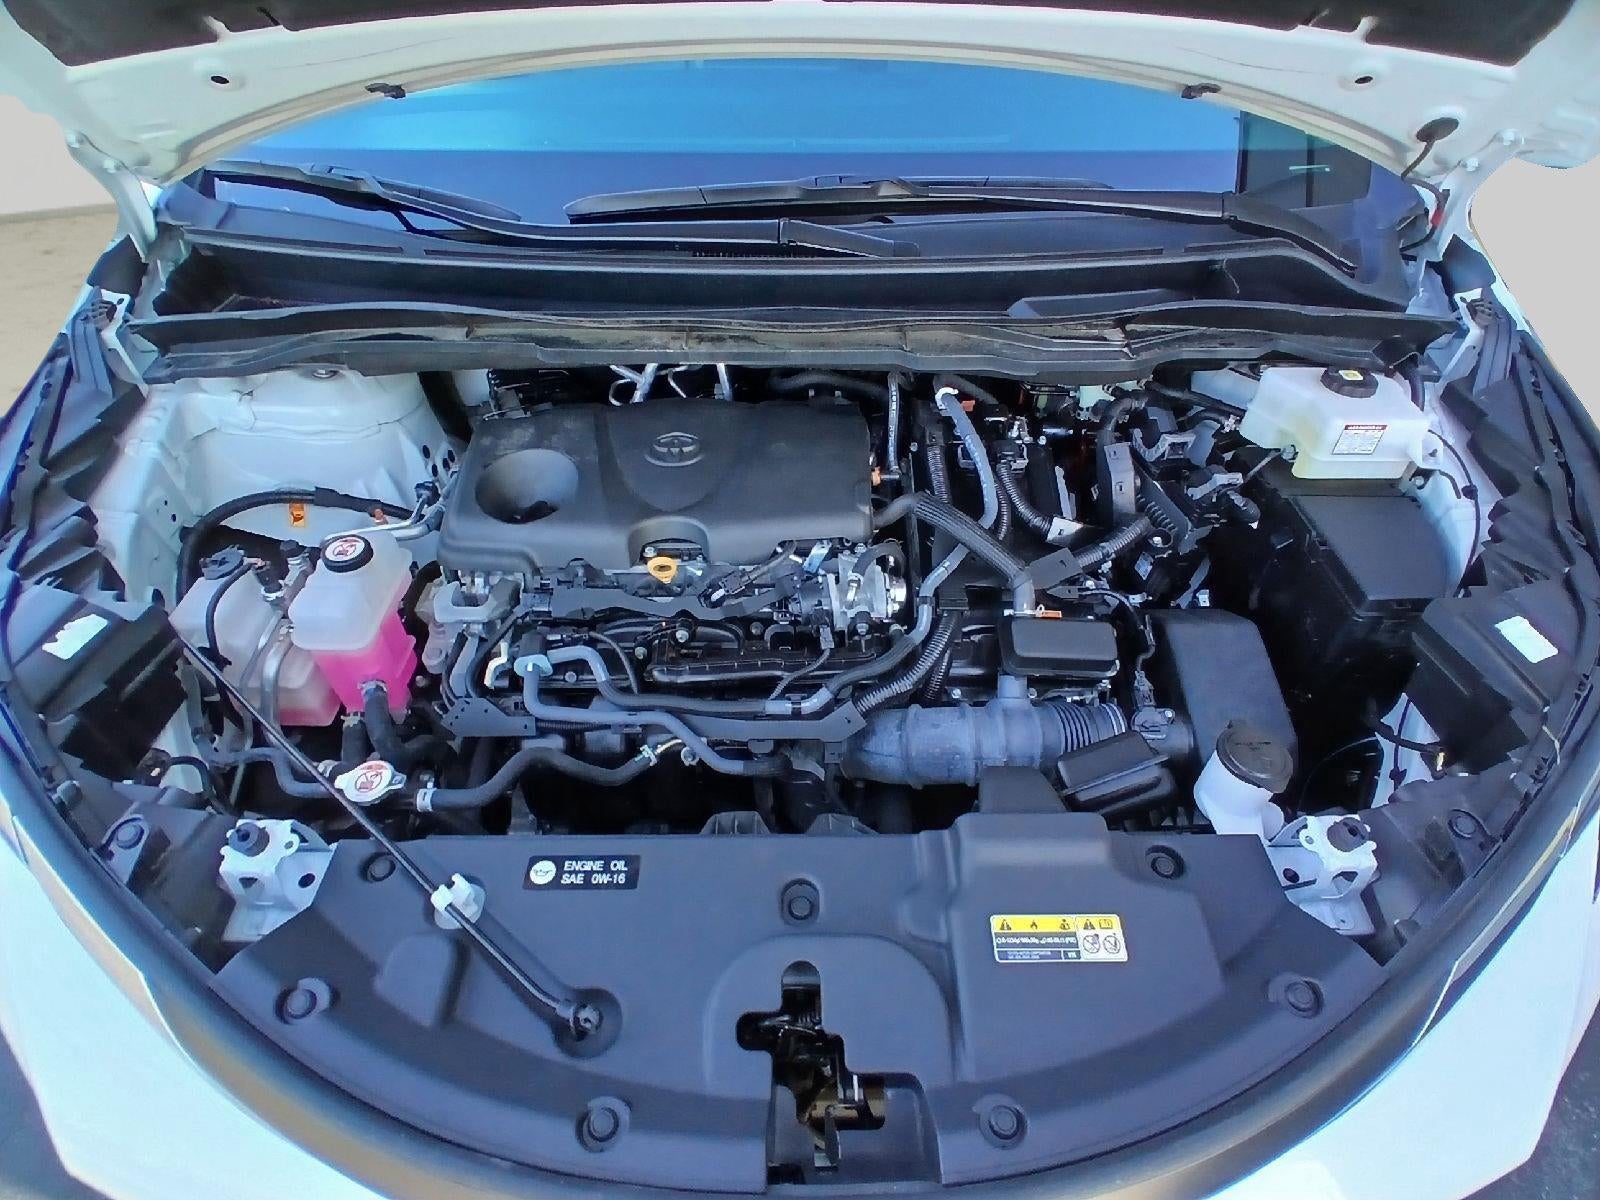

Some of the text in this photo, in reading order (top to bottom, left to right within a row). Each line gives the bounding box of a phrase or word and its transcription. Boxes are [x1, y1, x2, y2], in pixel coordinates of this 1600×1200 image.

[563, 860, 628, 871] ENGINE OIL
[560, 873, 626, 884] SAE 0W-16
